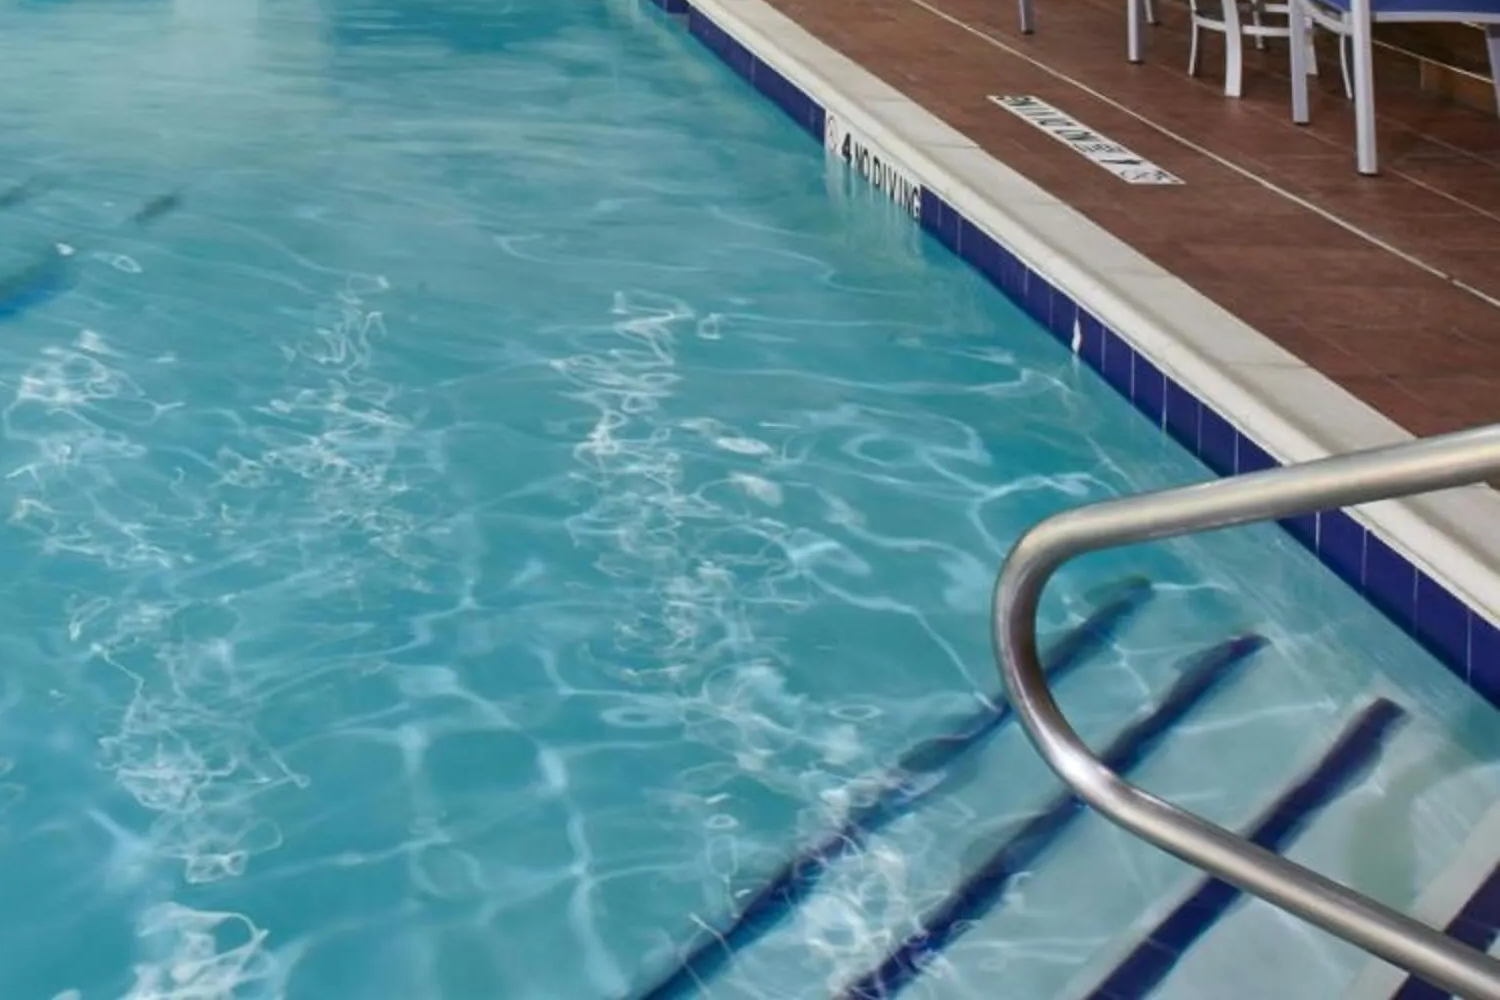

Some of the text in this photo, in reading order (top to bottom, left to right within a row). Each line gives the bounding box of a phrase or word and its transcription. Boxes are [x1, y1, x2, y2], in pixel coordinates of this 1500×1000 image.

[841, 131, 921, 221] 4 NO DIVING
